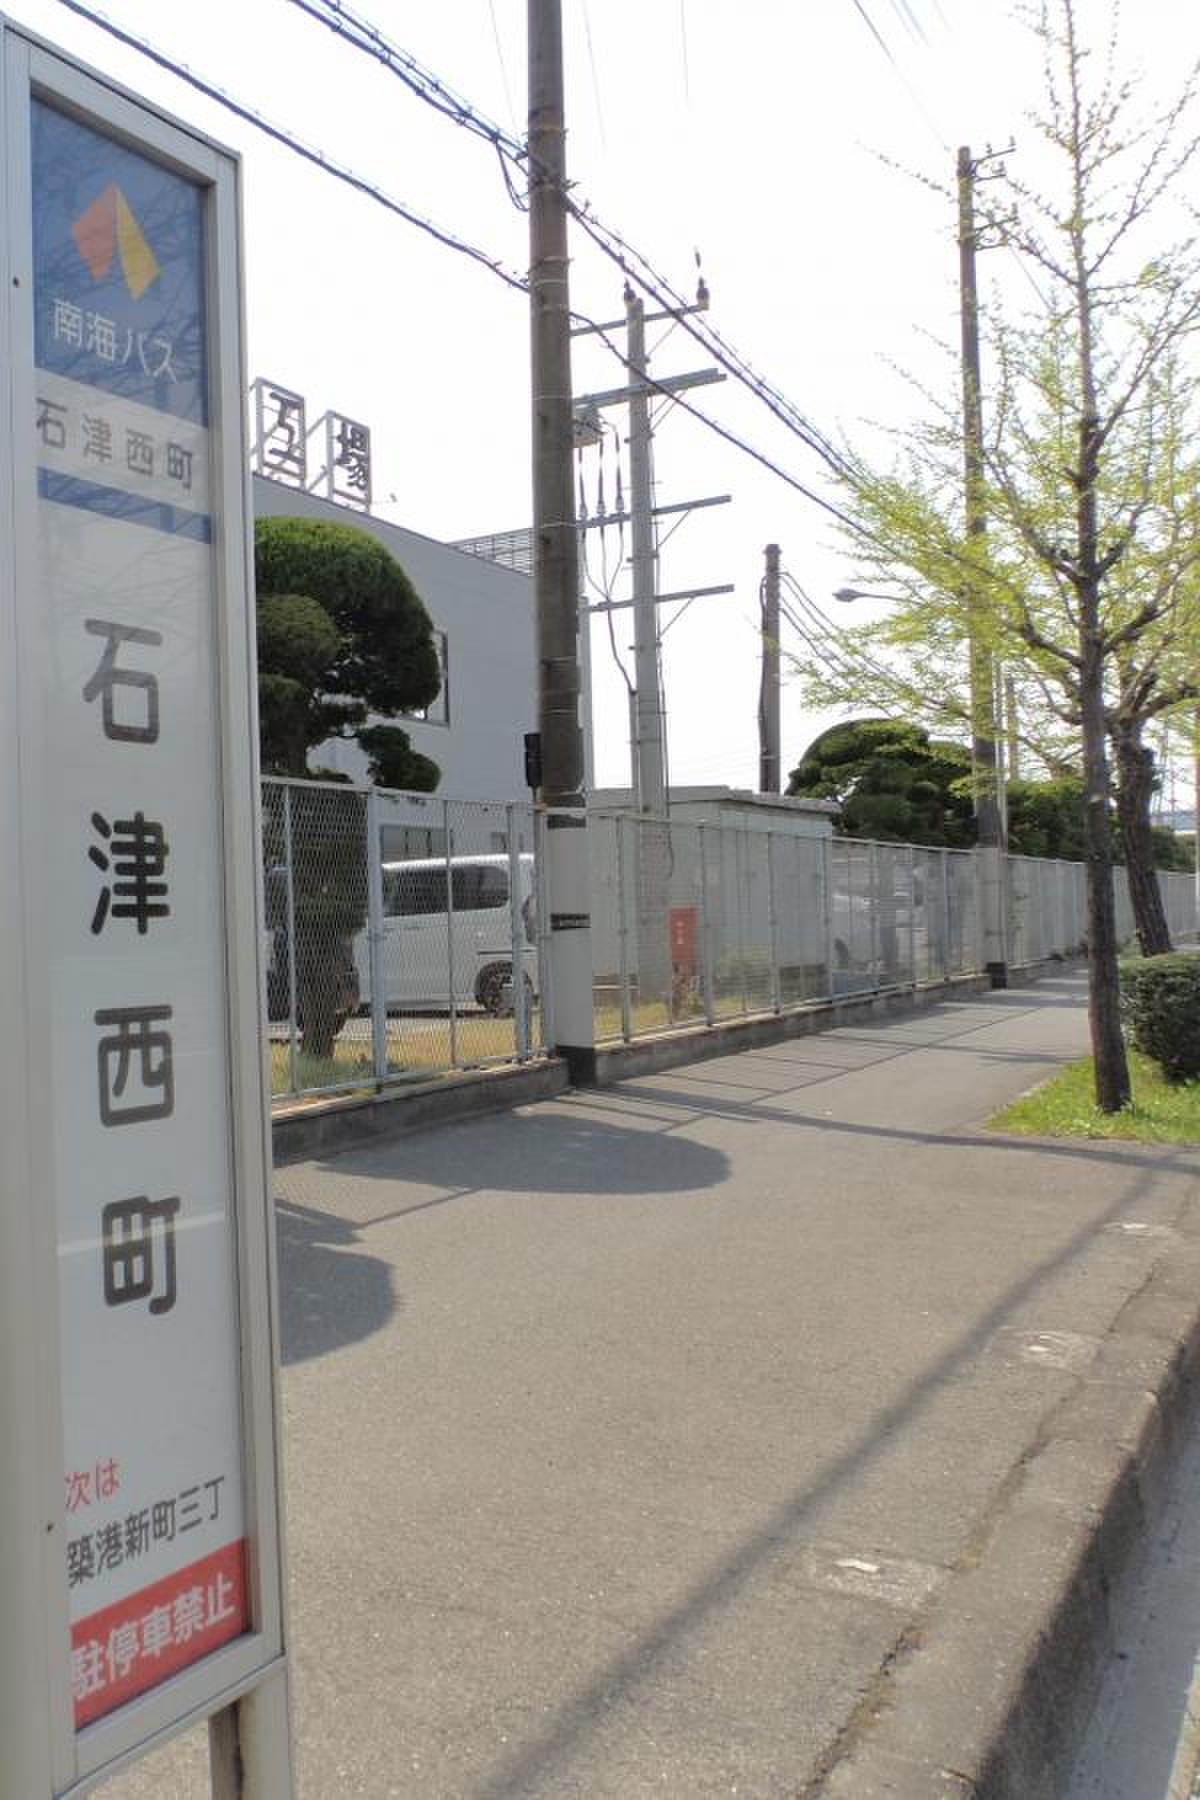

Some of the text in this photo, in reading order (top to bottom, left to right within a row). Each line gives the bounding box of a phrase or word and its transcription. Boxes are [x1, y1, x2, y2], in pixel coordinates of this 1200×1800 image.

[53, 299, 178, 384] 南海バス
[36, 397, 193, 490] 石津西町
[84, 618, 181, 1316] 石津西町
[65, 1458, 121, 1513] 次は
[67, 1475, 225, 1588] 築港新町三丁
[70, 1572, 236, 1701] 駐停車禁止
